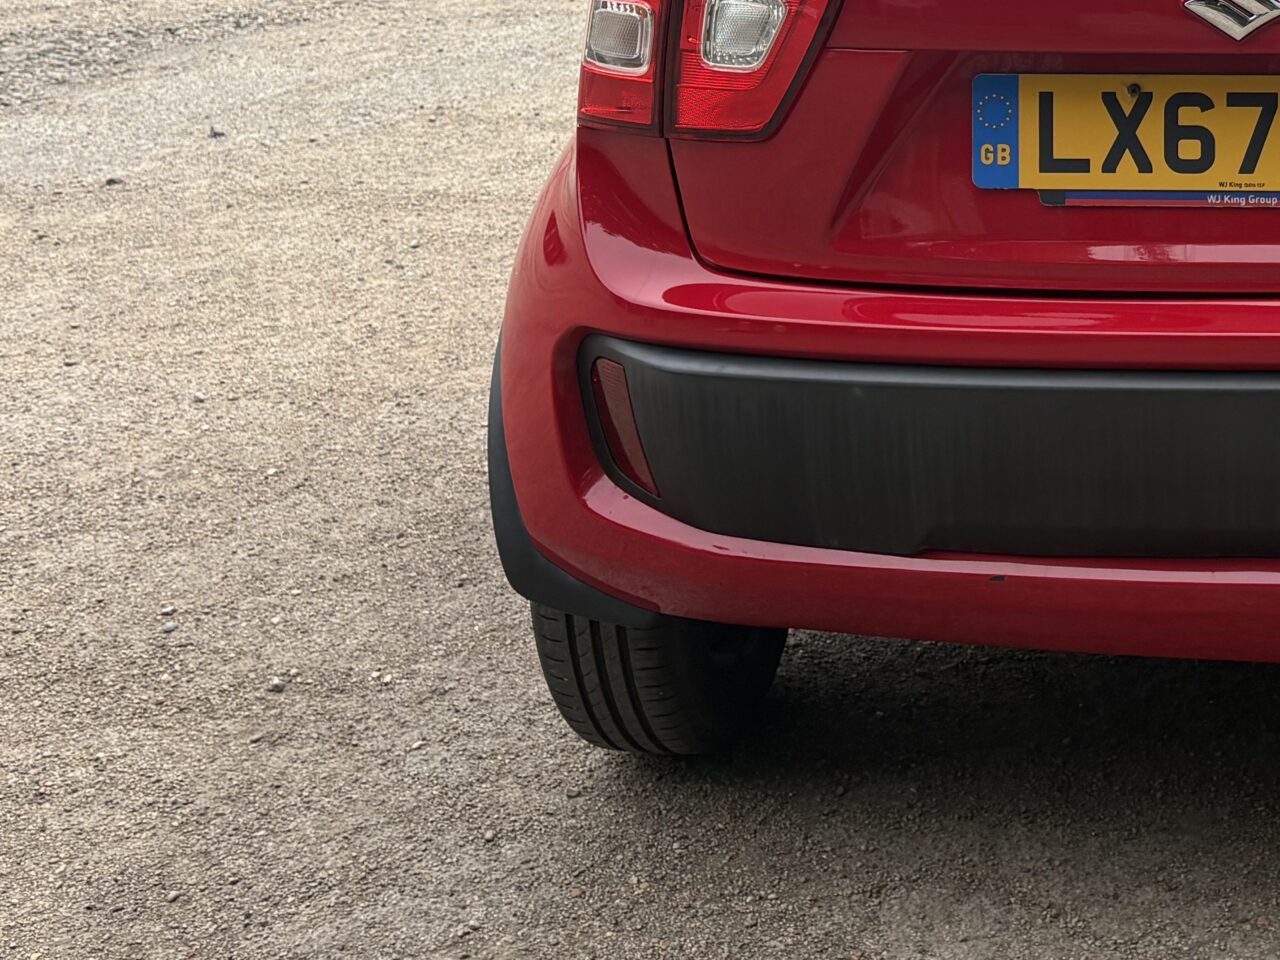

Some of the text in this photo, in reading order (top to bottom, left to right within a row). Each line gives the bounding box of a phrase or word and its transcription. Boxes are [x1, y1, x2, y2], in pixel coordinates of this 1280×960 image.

[1038, 91, 1279, 175] LX67
[980, 143, 1012, 166] GB
[1228, 181, 1243, 189] King
[1207, 194, 1278, 206] WJ King Group
